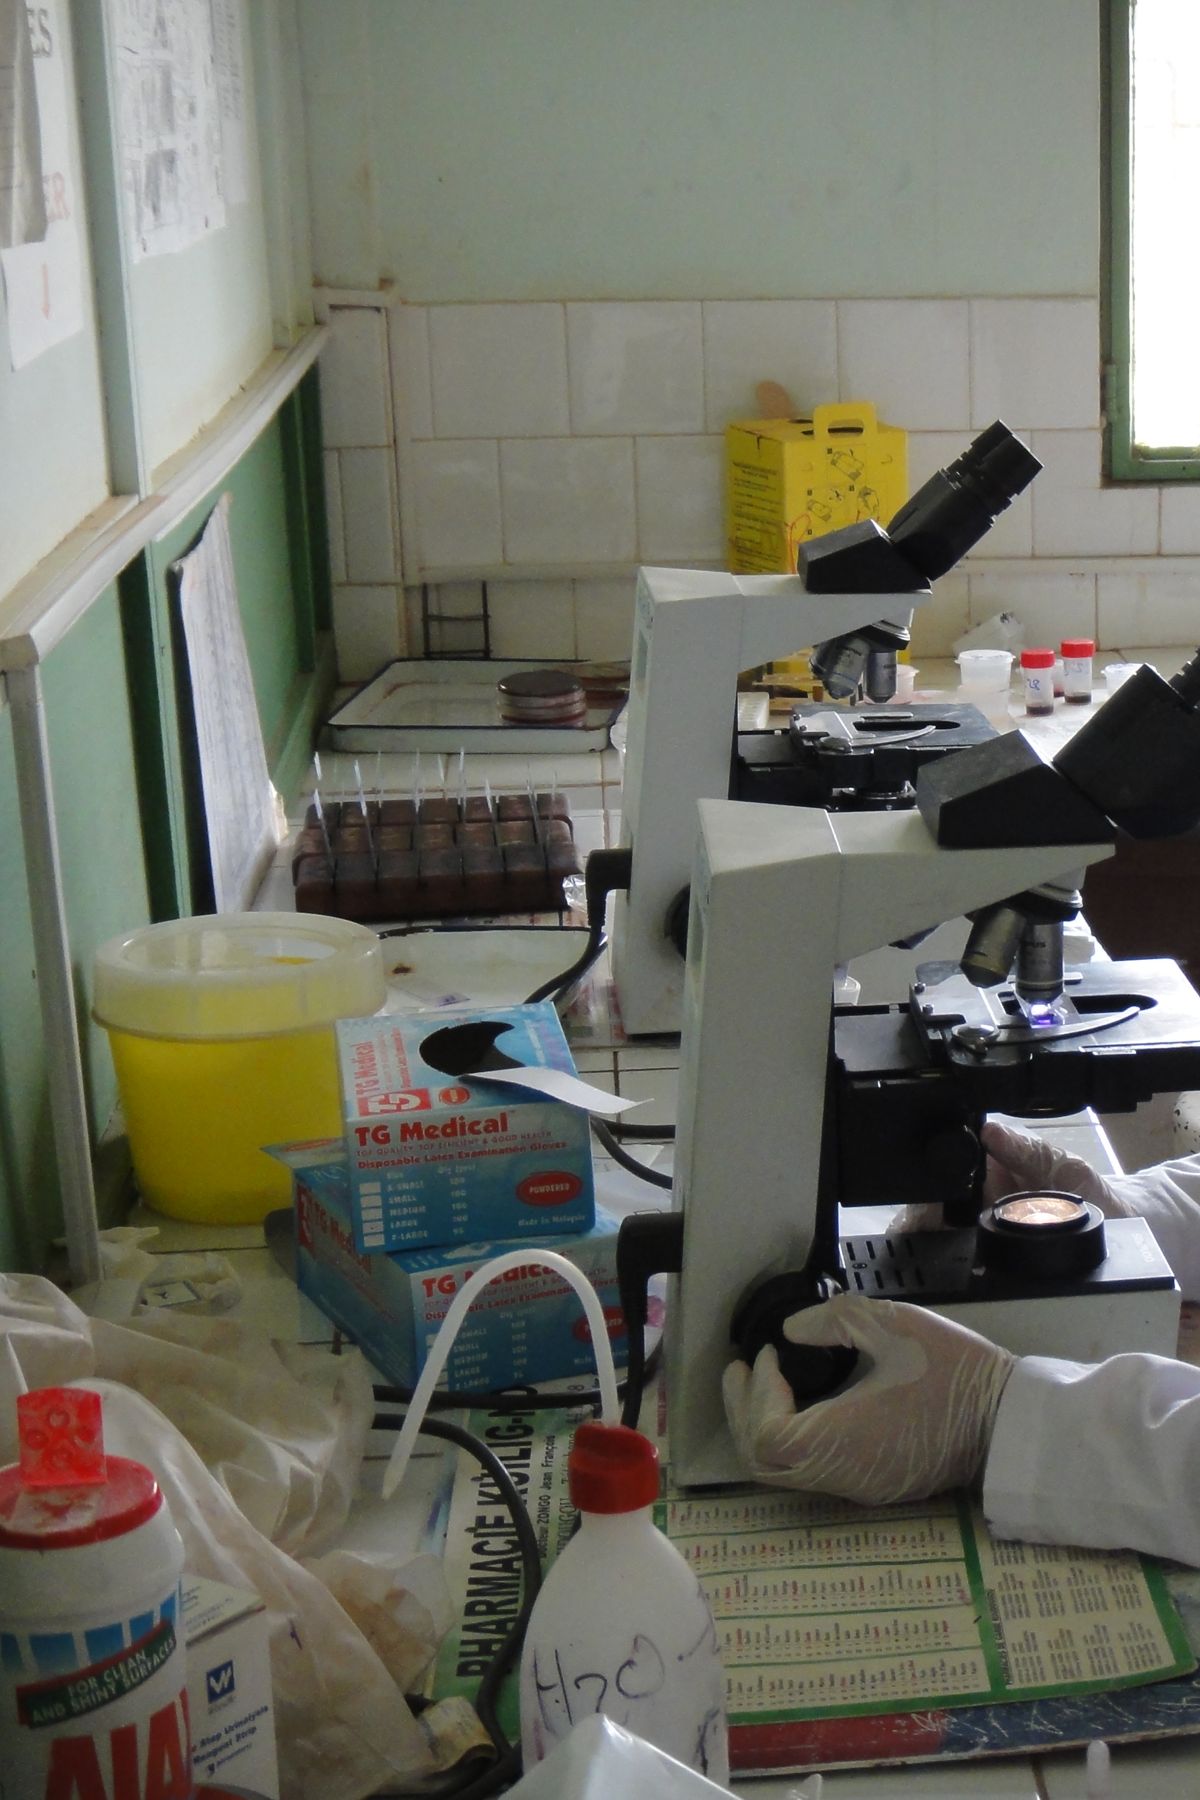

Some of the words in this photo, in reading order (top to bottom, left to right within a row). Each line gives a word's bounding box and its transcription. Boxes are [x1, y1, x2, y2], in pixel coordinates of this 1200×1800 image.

[354, 1124, 391, 1147] TG
[400, 1111, 509, 1143] Medical
[357, 1157, 422, 1169] Disposable
[424, 1152, 455, 1163] Latex
[457, 1145, 527, 1161] Examination
[529, 1140, 568, 1152] Gloves
[529, 1182, 571, 1194] POWDERED
[422, 1275, 456, 1297] TG
[542, 1434, 559, 1468] François
[539, 1471, 553, 1491] Jean
[536, 1494, 552, 1525] ZONGO
[32, 1702, 67, 1723] AND
[70, 1682, 117, 1713] SHINY
[120, 1637, 176, 1690] SURFACES
[67, 1676, 99, 1697] FOR
[103, 1649, 147, 1682] CLEAN
[223, 1703, 269, 1737] Urinalysis
